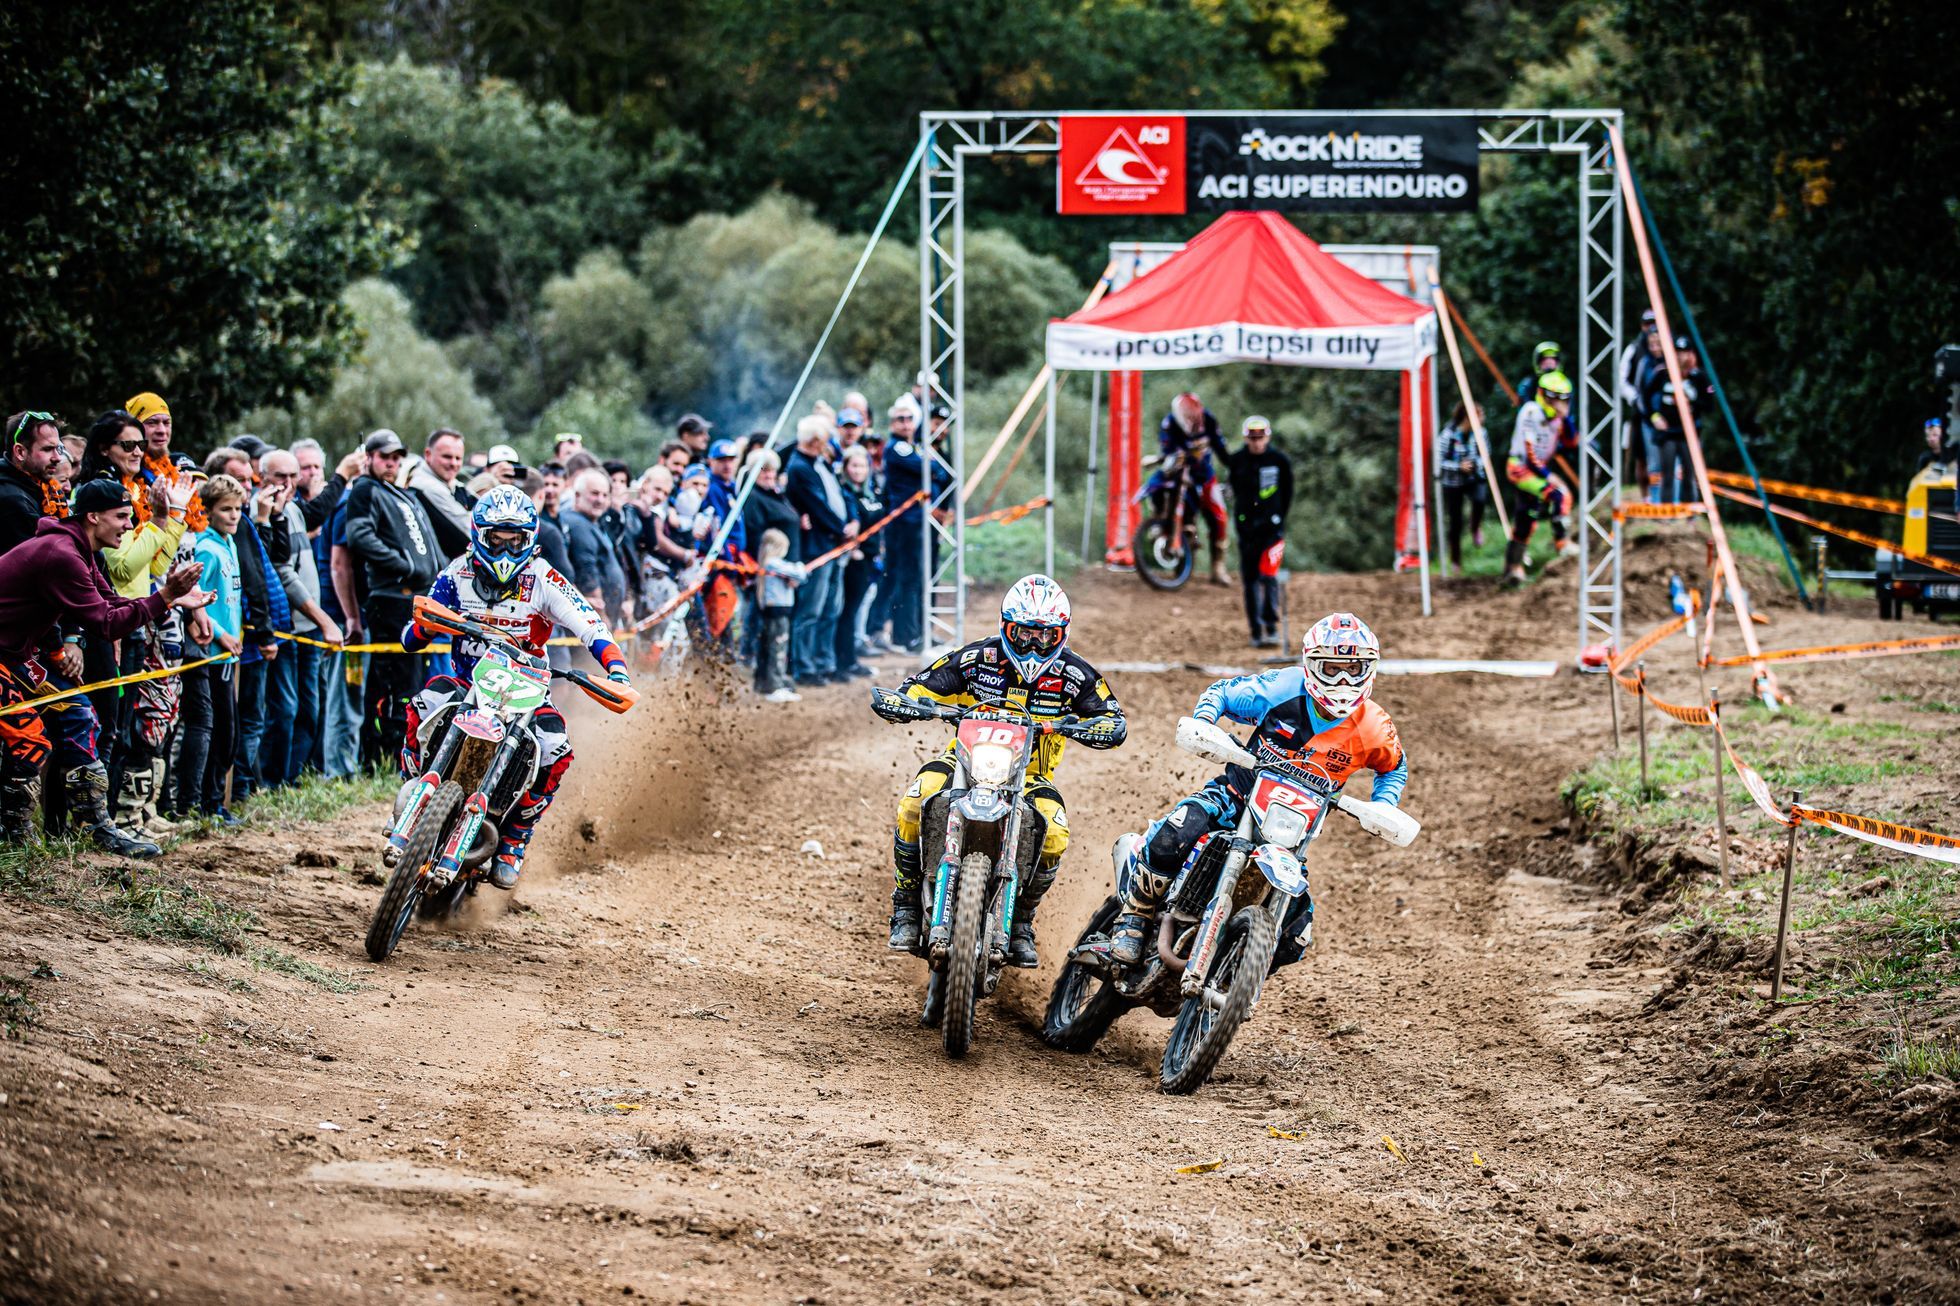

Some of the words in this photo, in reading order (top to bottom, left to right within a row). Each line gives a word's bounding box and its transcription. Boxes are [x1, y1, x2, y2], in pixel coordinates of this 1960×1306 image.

[1138, 126, 1169, 144] ACI
[1198, 174, 1248, 198] ACI
[1253, 174, 1468, 198] SUPERENDURO
[477, 668, 545, 700] 97
[879, 704, 920, 716] ACERBIS
[976, 726, 1014, 745] 10
[1268, 785, 1321, 811] 87
[942, 876, 955, 923] METZELER
